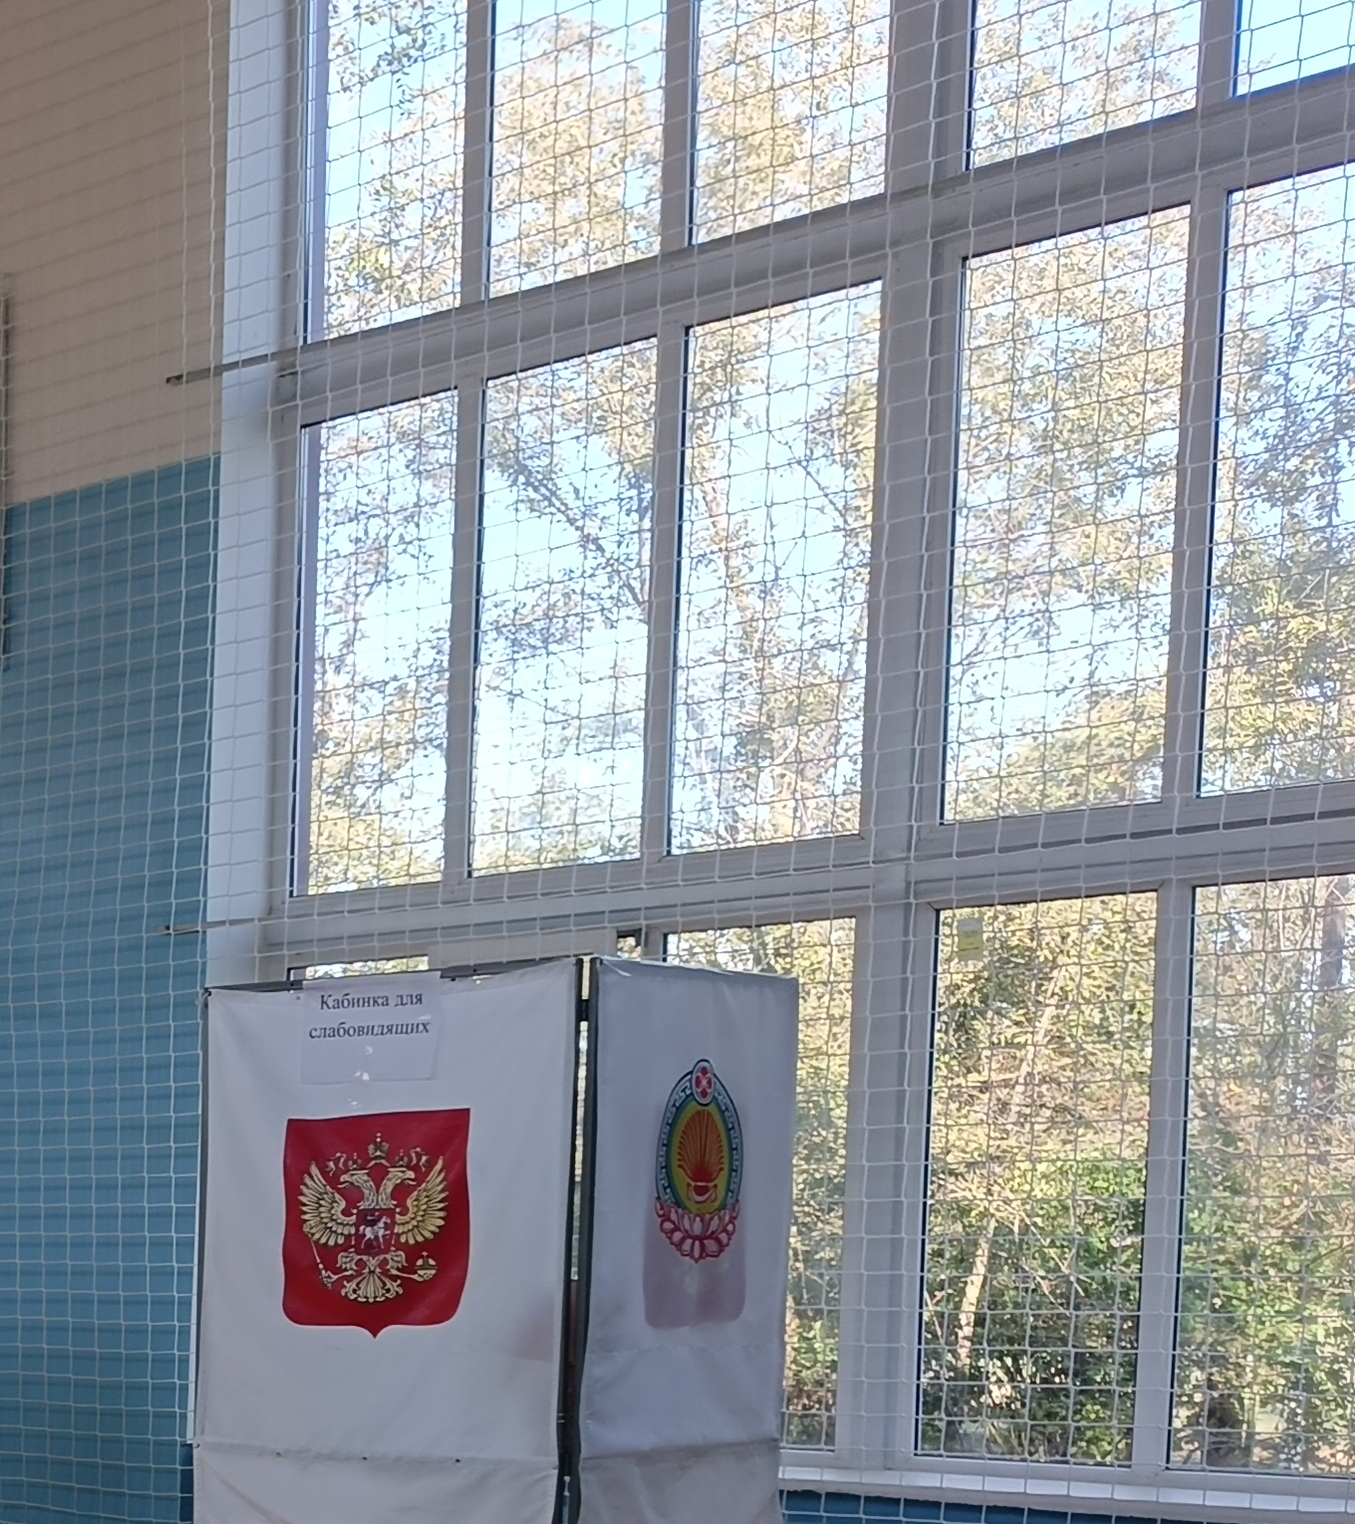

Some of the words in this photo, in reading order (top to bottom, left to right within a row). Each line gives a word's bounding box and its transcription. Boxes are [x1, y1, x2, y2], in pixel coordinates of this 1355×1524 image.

[320, 993, 389, 1010] Кабинка
[394, 993, 423, 1008] для
[309, 1021, 430, 1039] слабовидящих
